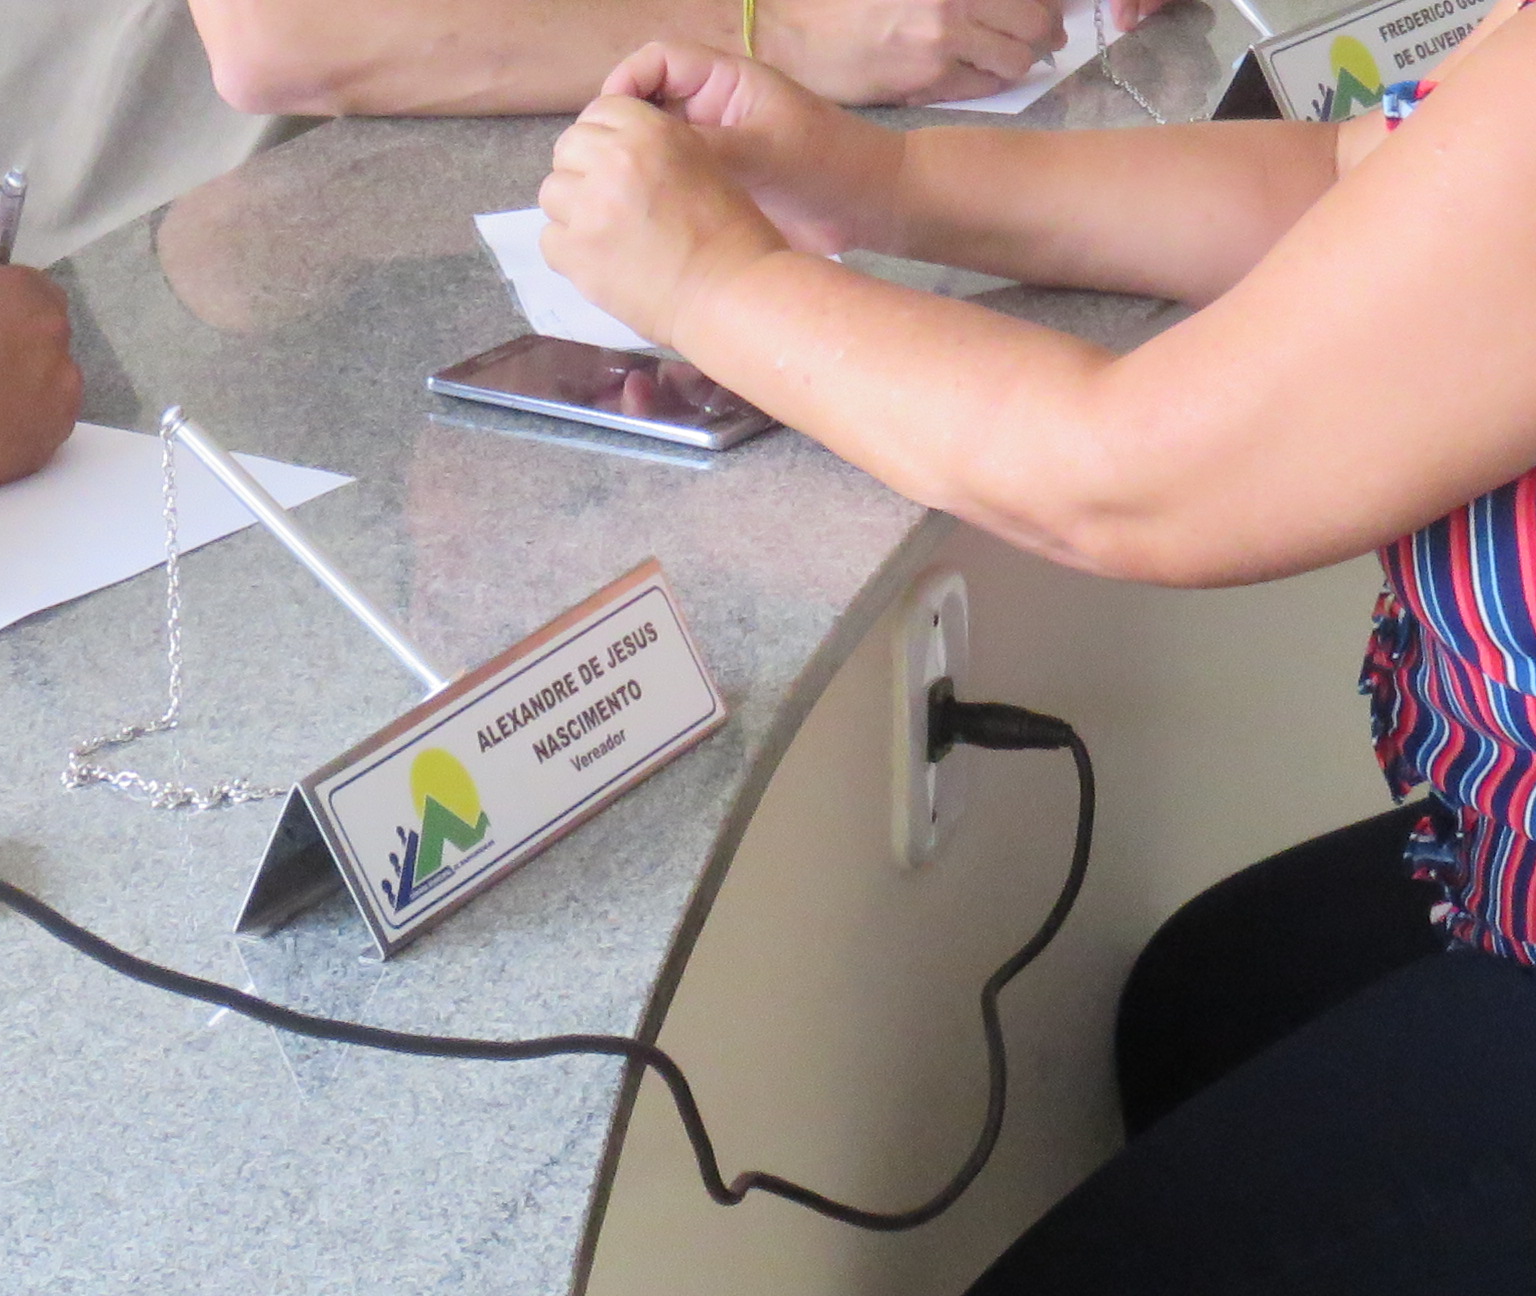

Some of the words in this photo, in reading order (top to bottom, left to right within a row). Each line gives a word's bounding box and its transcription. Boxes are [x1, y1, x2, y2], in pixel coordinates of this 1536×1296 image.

[1378, 0, 1455, 43] FREDERICO
[1393, 46, 1416, 70] DE
[476, 672, 580, 753] ALEXANDRE
[577, 656, 605, 686] DE
[606, 621, 659, 669] JESUS
[531, 679, 643, 764] NASCIMENTO
[569, 729, 627, 772] Vereador
